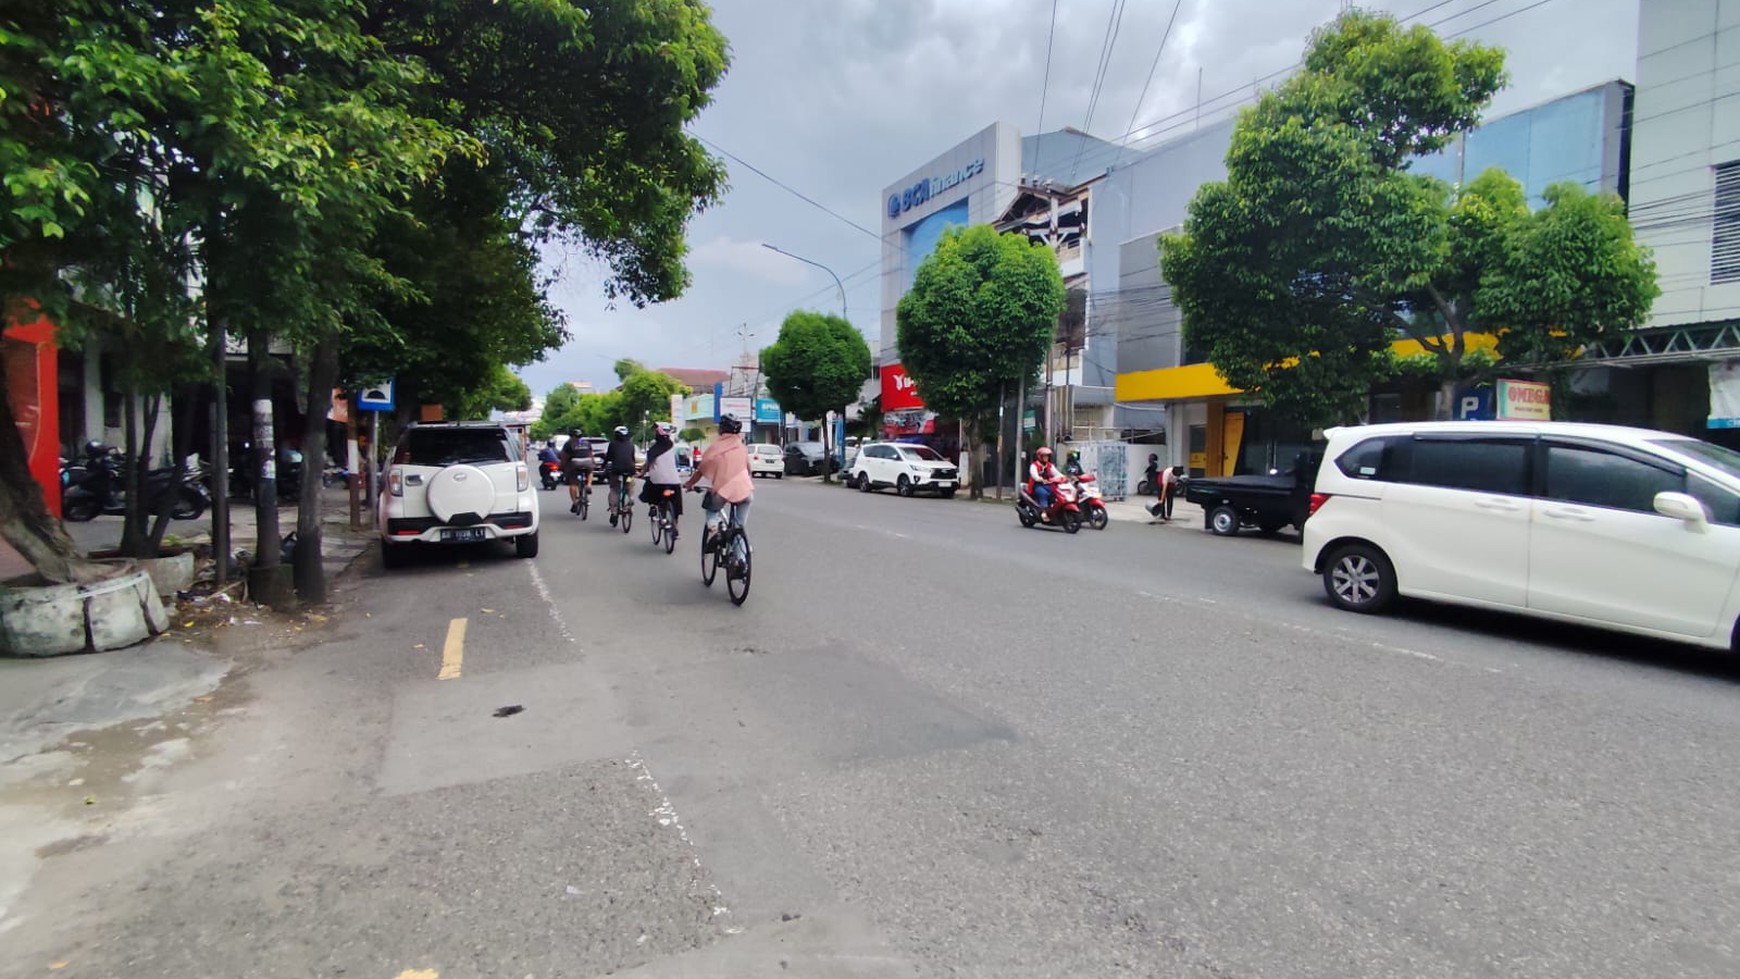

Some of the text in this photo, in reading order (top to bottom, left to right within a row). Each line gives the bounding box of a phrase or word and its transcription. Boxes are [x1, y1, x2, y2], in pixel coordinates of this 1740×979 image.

[901, 157, 985, 213] BCA finance
[1508, 386, 1550, 405] OMEGA
[1460, 396, 1479, 419] P
